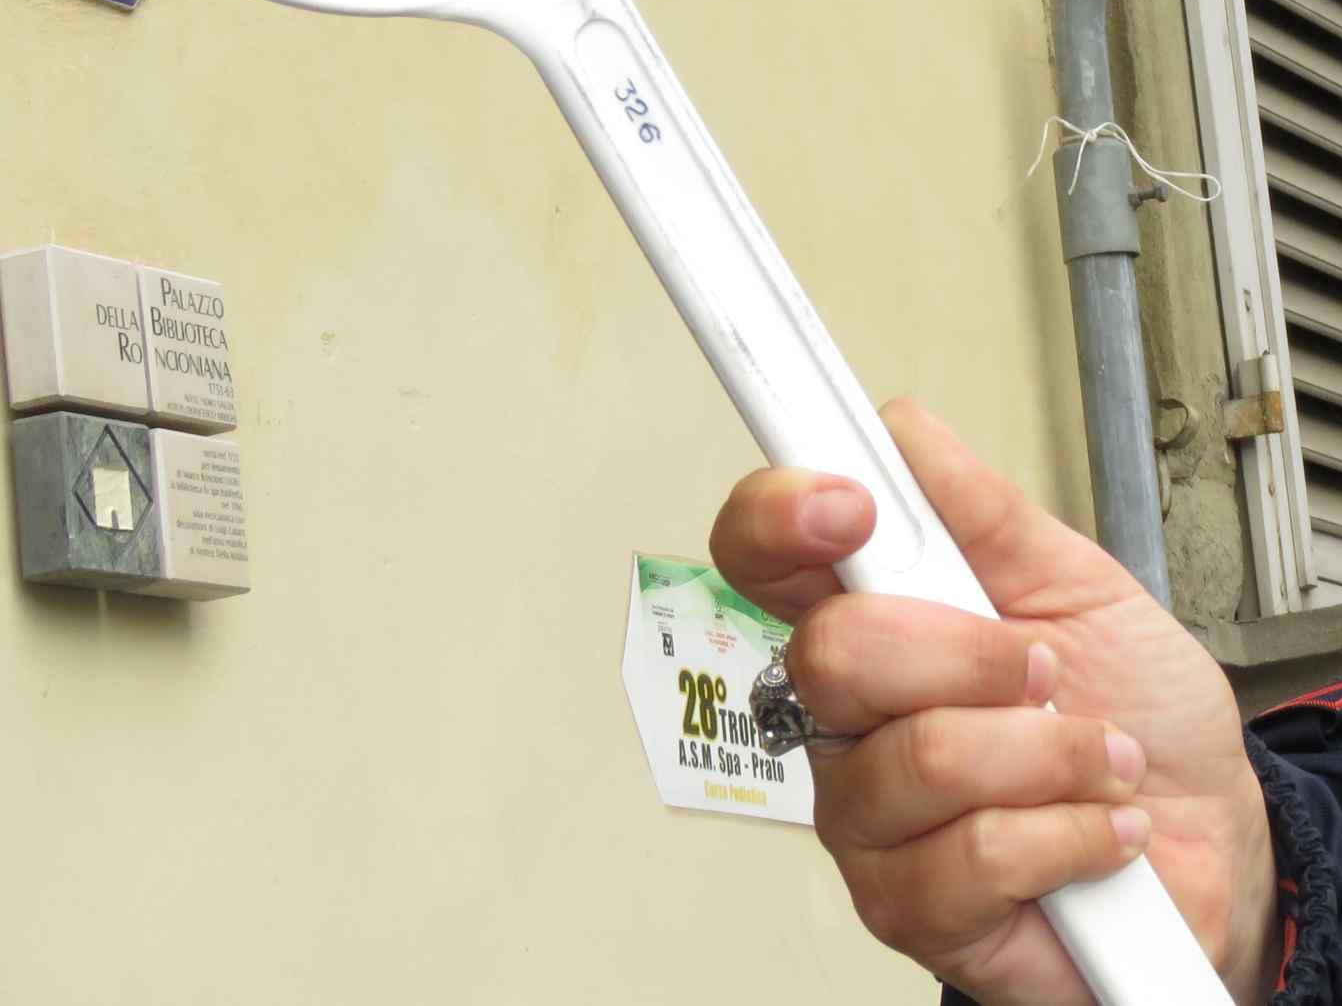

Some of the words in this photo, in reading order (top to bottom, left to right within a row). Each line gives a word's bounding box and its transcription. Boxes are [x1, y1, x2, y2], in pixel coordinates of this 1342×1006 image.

[614, 77, 661, 143] 326
[96, 304, 139, 331] DELLA
[719, 708, 762, 748] TROF
[679, 739, 716, 772] A.S.M.
[718, 745, 741, 776] Spa
[751, 752, 785, 784] Prato
